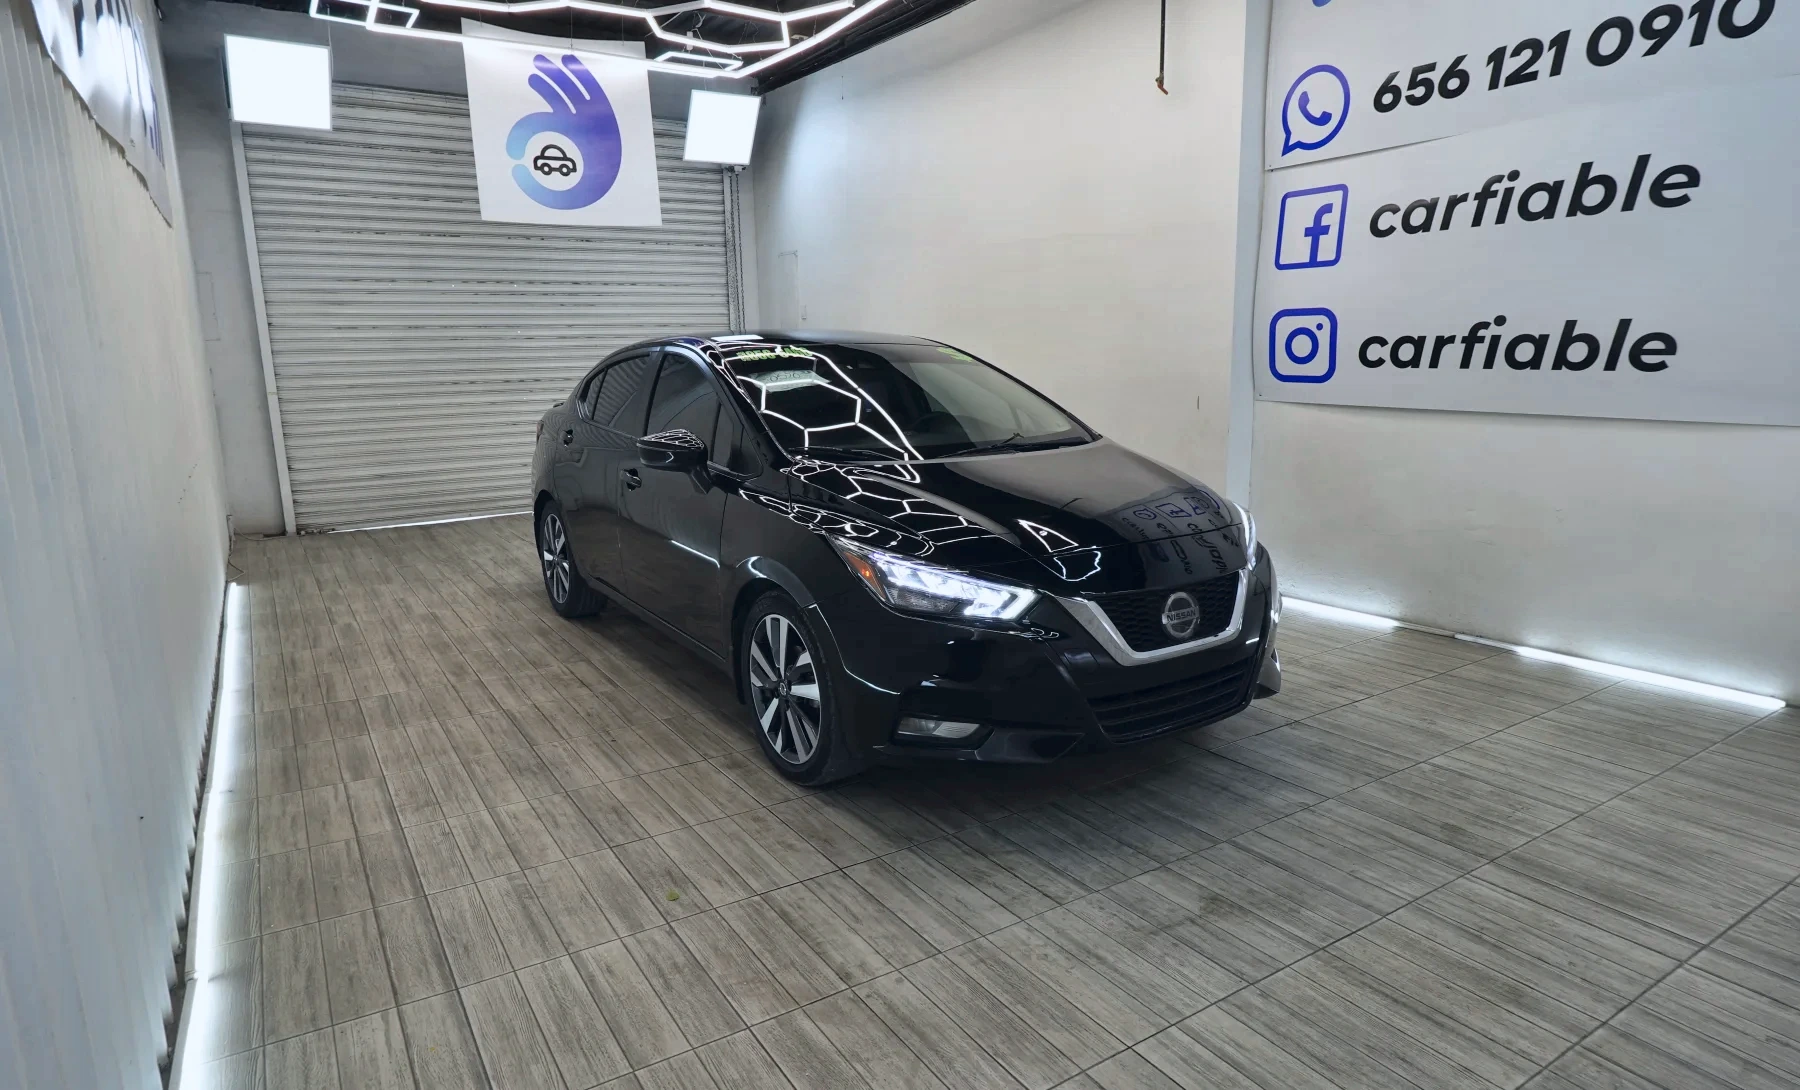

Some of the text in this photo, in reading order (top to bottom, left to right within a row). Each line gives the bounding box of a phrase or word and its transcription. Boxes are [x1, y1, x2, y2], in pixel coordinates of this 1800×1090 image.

[1373, 0, 1776, 113] 656 121 0910
[1369, 153, 1700, 238] carfiable
[1358, 315, 1677, 373] carfiable
[1166, 609, 1196, 622] NISSAN
